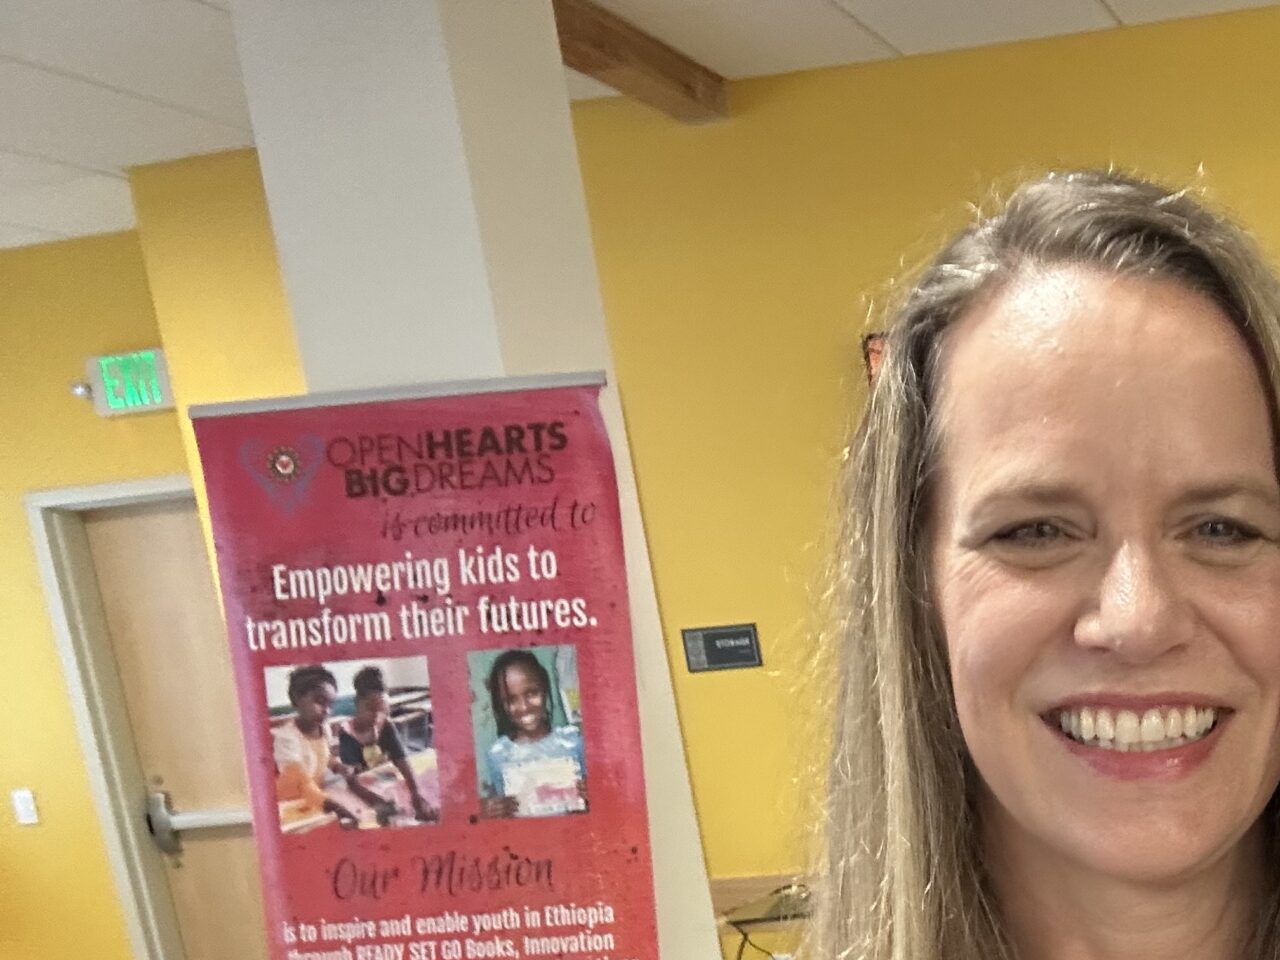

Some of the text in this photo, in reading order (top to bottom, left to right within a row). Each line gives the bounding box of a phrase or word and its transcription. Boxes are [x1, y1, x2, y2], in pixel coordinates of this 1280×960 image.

[413, 496, 560, 535] committed
[569, 497, 598, 530] to
[271, 544, 559, 604] Empowering kids to
[245, 595, 599, 651] transform their futures.
[332, 850, 555, 900] Our Mission
[283, 901, 614, 944] is to inspire and enable youth in Ethiopia
[440, 940, 462, 960] GO
[465, 935, 520, 960] Books,
[523, 929, 615, 956] Innovation
